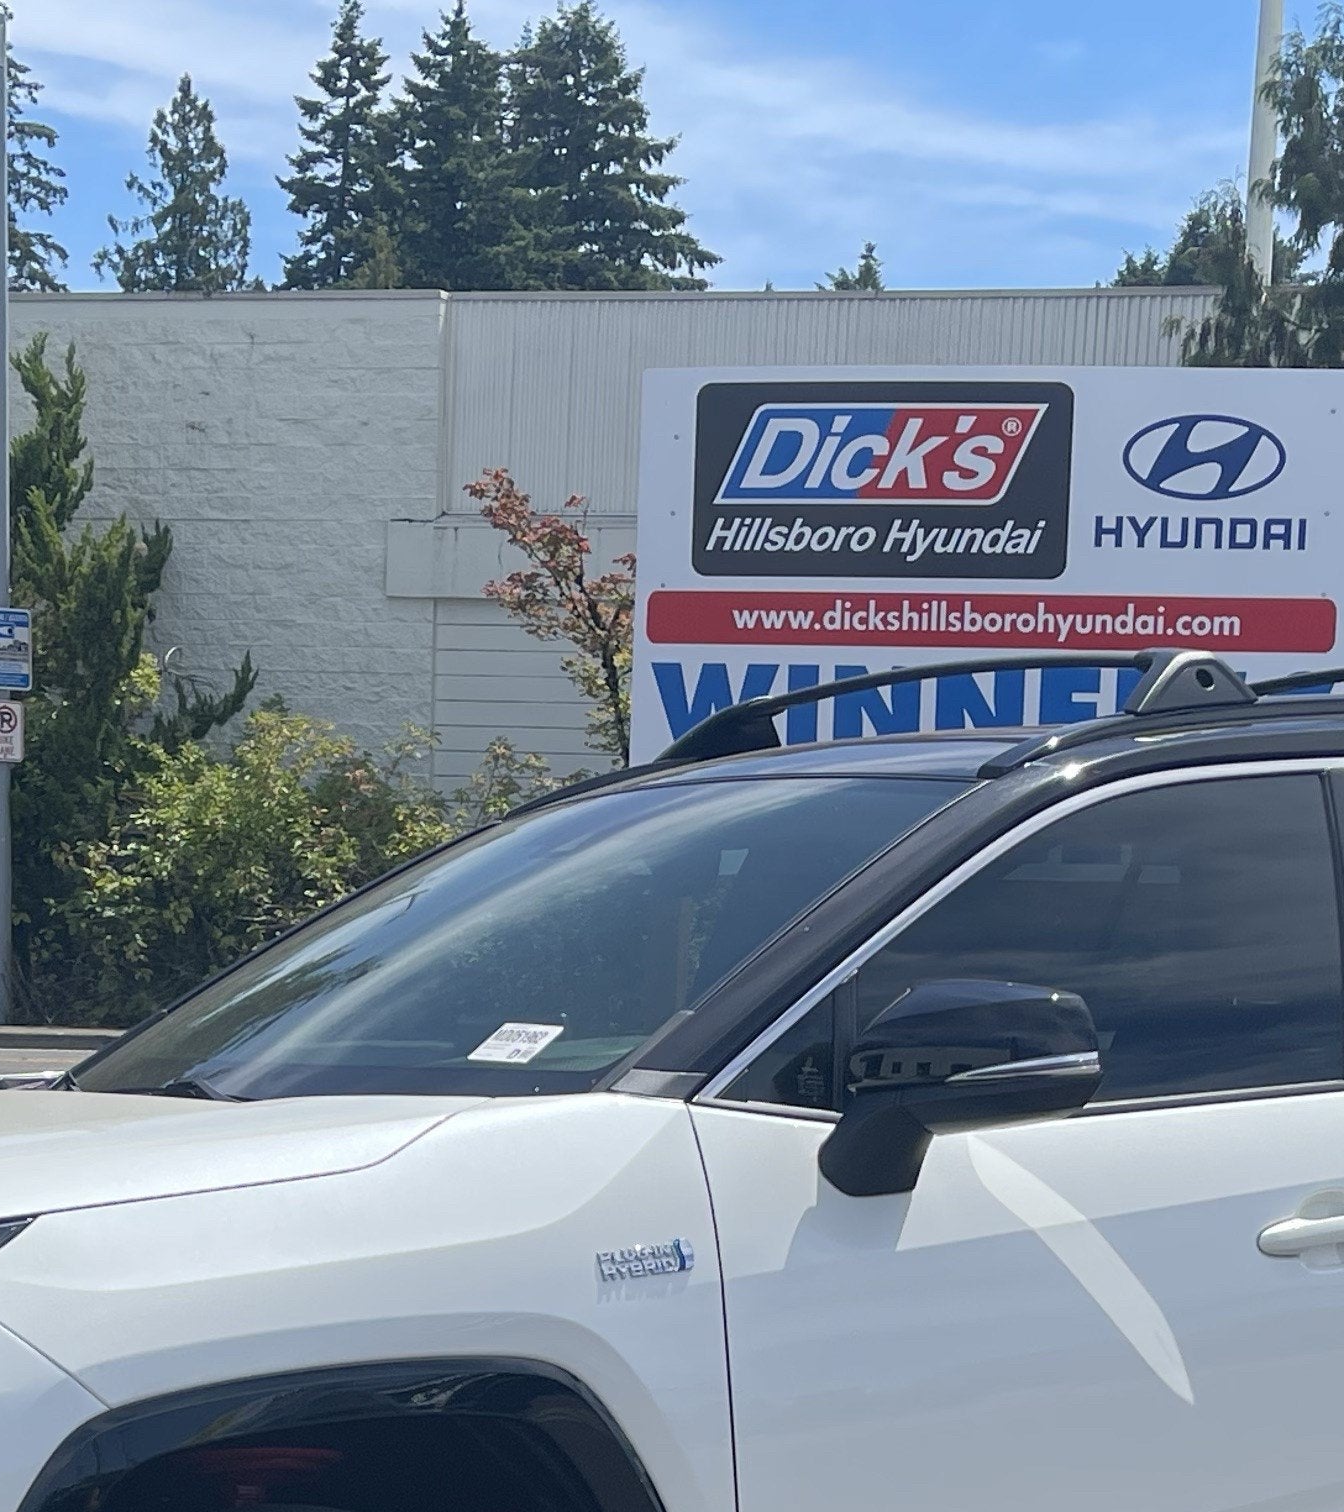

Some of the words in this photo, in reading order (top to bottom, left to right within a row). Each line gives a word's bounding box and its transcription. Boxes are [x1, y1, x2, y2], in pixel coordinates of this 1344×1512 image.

[740, 414, 1005, 492] Dick's
[706, 517, 876, 556] Hillsboro
[883, 518, 1047, 562] Hyundai
[1094, 515, 1307, 551] HYUNDAI
[732, 599, 1242, 643] www.dickshillsborohyundai.com
[599, 1258, 679, 1282] HYBRID
